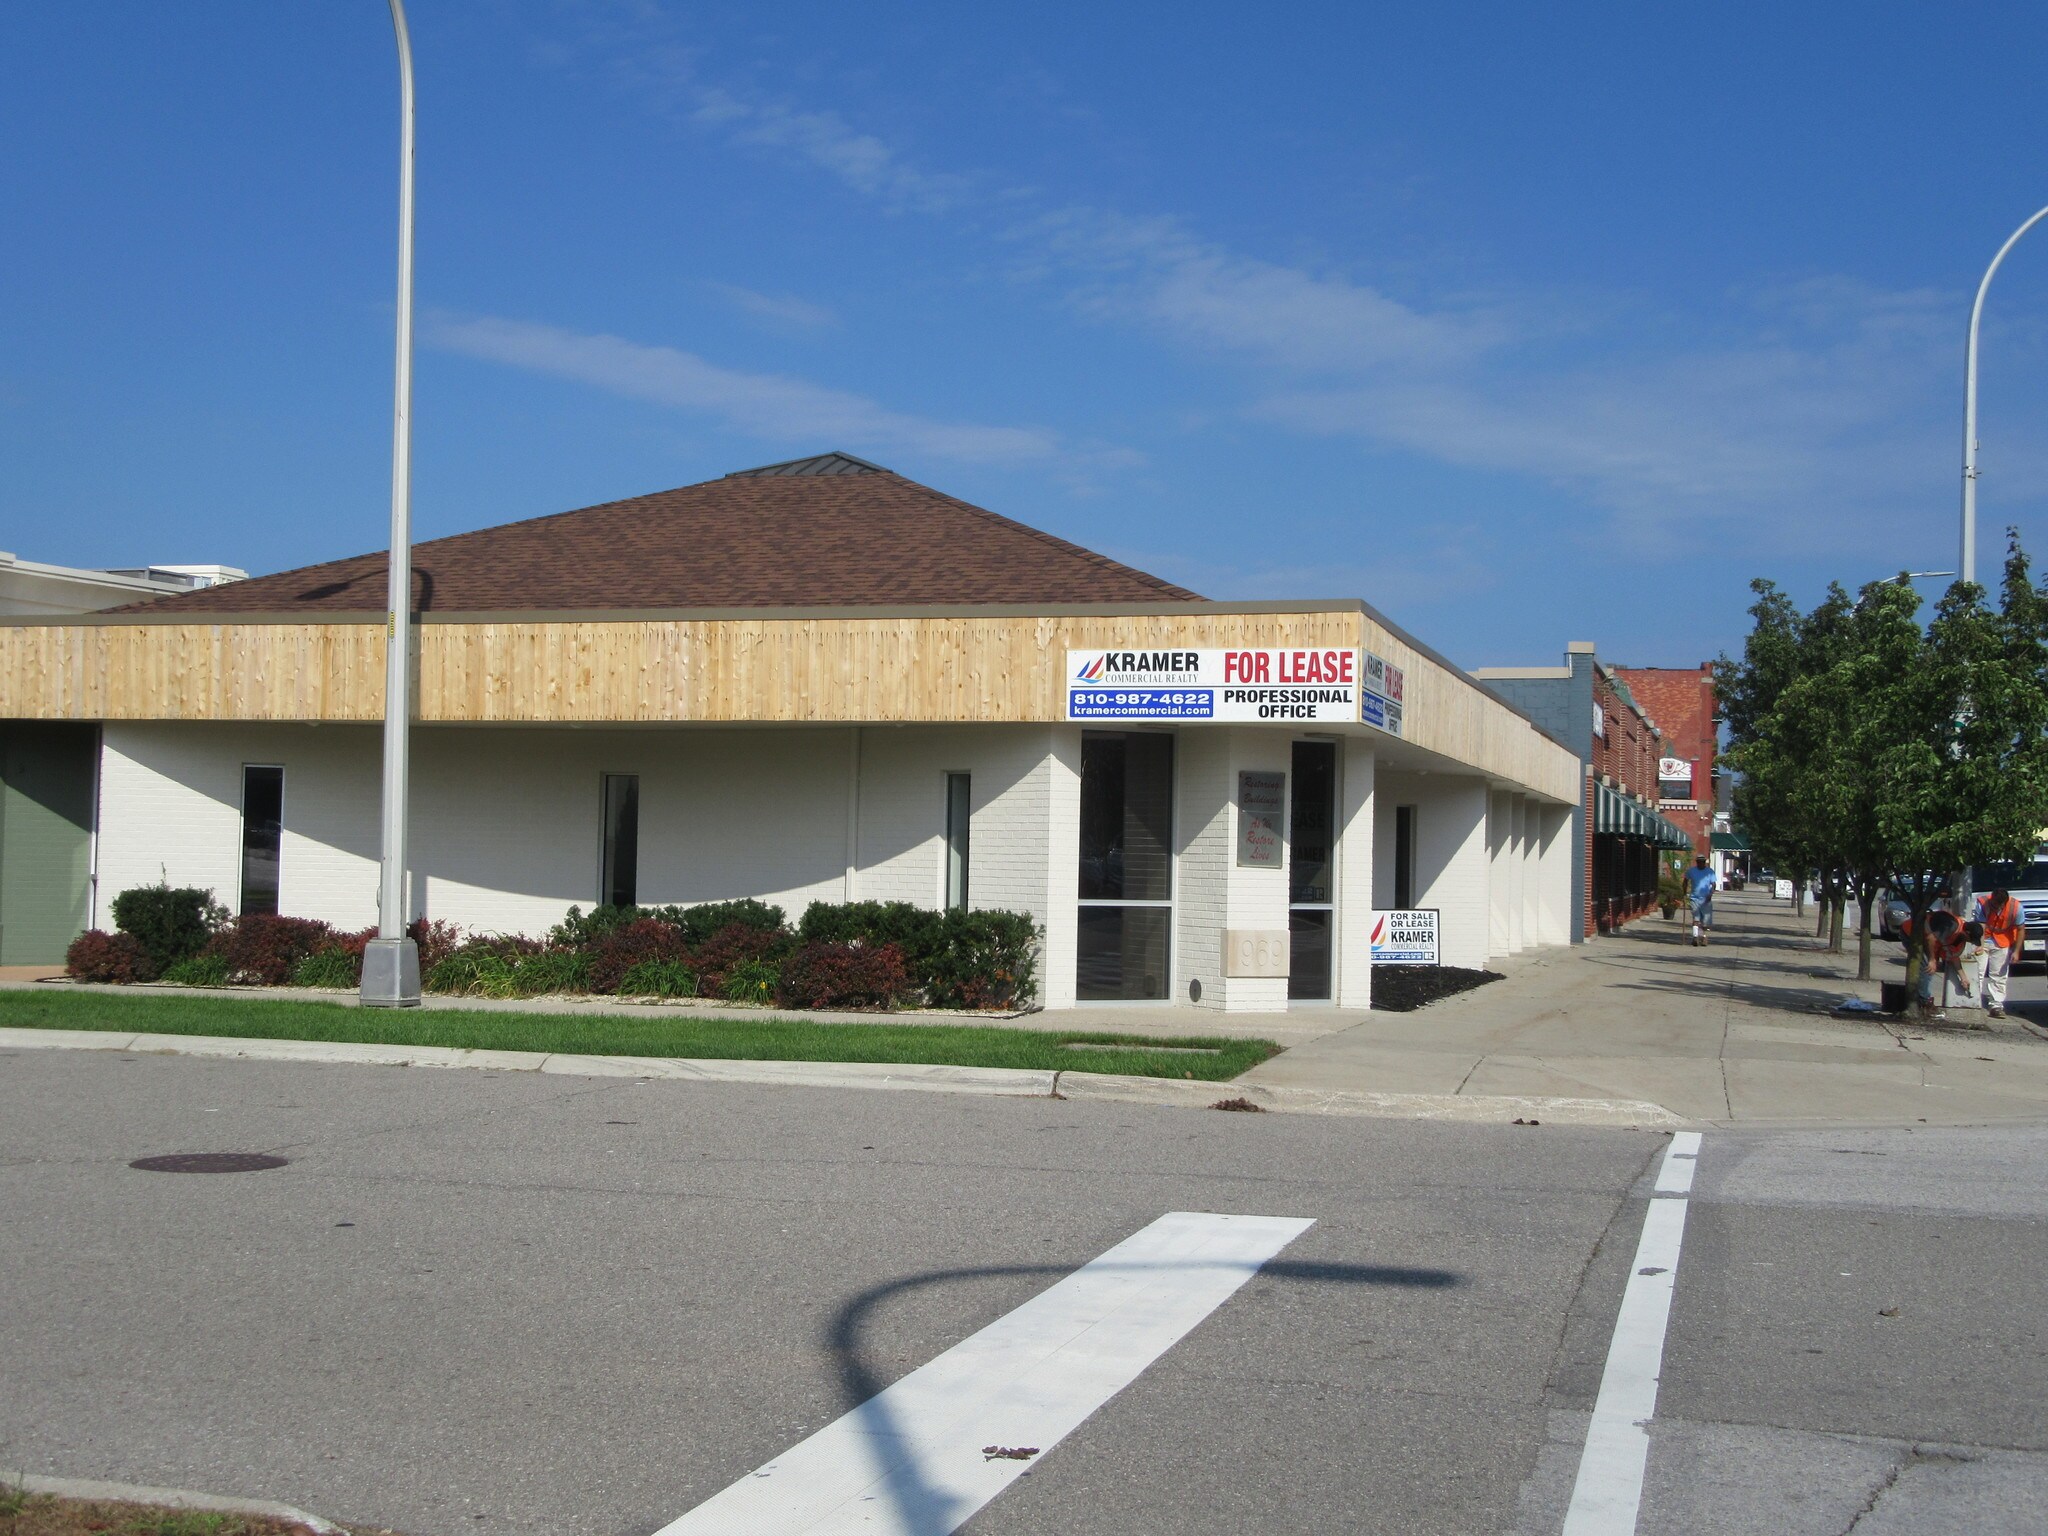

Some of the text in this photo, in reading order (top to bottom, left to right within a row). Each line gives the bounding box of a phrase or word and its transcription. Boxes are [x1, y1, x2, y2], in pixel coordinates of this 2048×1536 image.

[1105, 652, 1199, 672] KRAMER
[1224, 652, 1353, 683] FOR LEASE
[1105, 673, 1199, 683] COMMERCIAL REALTY
[1074, 694, 1210, 705] 810-987-4622
[1224, 690, 1352, 704] PROFESSIONAL
[1074, 705, 1210, 715] kramercommercial.com
[1258, 705, 1317, 718] OFFICE
[1391, 920, 1434, 928] OR LEASE
[1391, 931, 1434, 943] KRAMER
